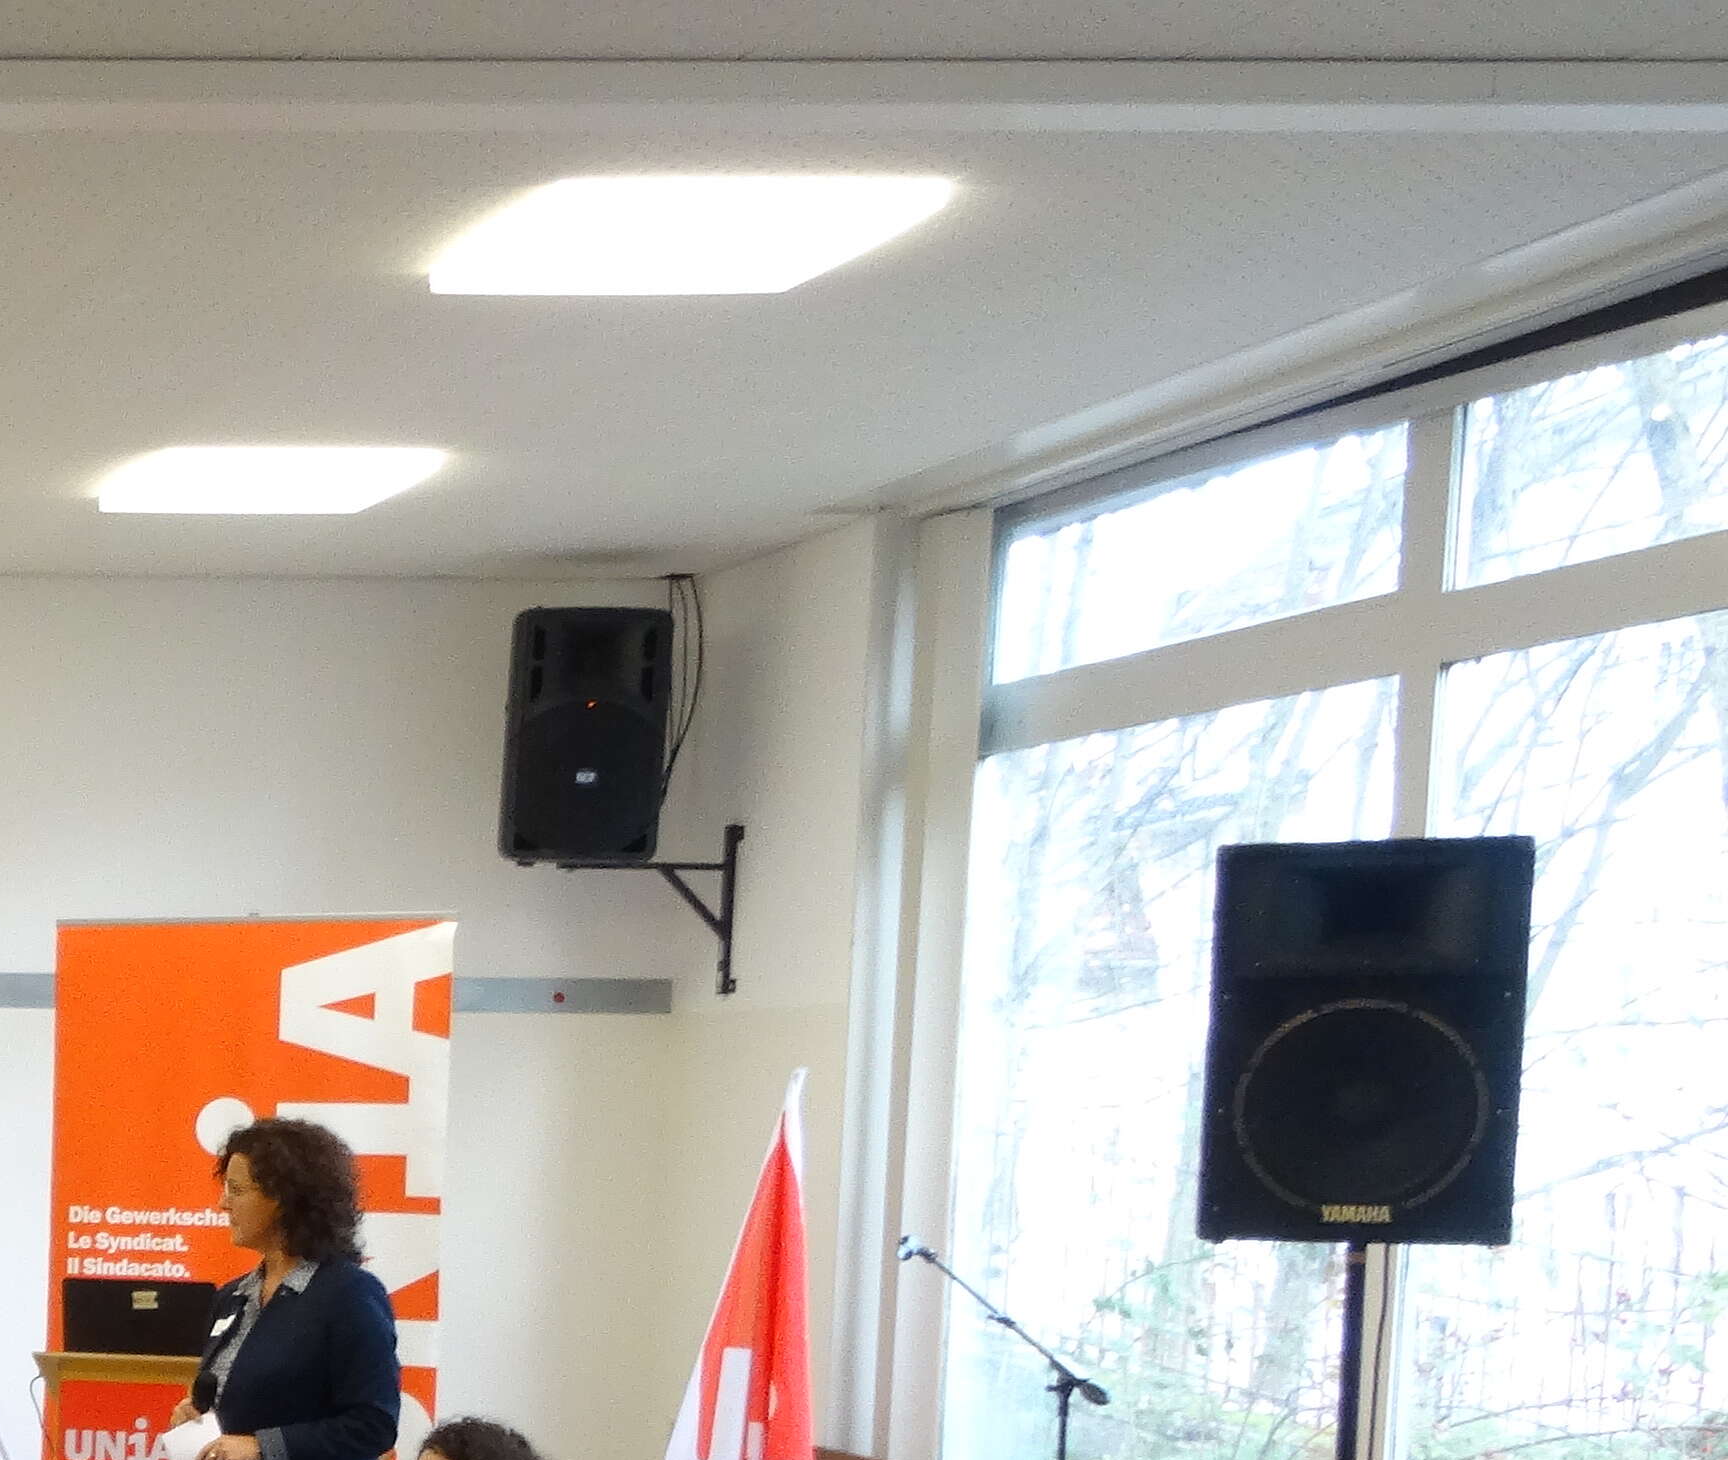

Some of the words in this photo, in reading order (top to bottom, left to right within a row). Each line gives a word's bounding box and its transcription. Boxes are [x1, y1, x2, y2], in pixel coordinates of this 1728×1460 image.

[67, 1205, 102, 1224] Die
[104, 1206, 231, 1227] Gewerkscha
[1320, 1205, 1393, 1223] YAMAHA
[67, 1231, 92, 1249] Le
[94, 1231, 190, 1255] Syndicat.
[66, 1257, 79, 1275] Il
[82, 1257, 192, 1278] Sindacato.
